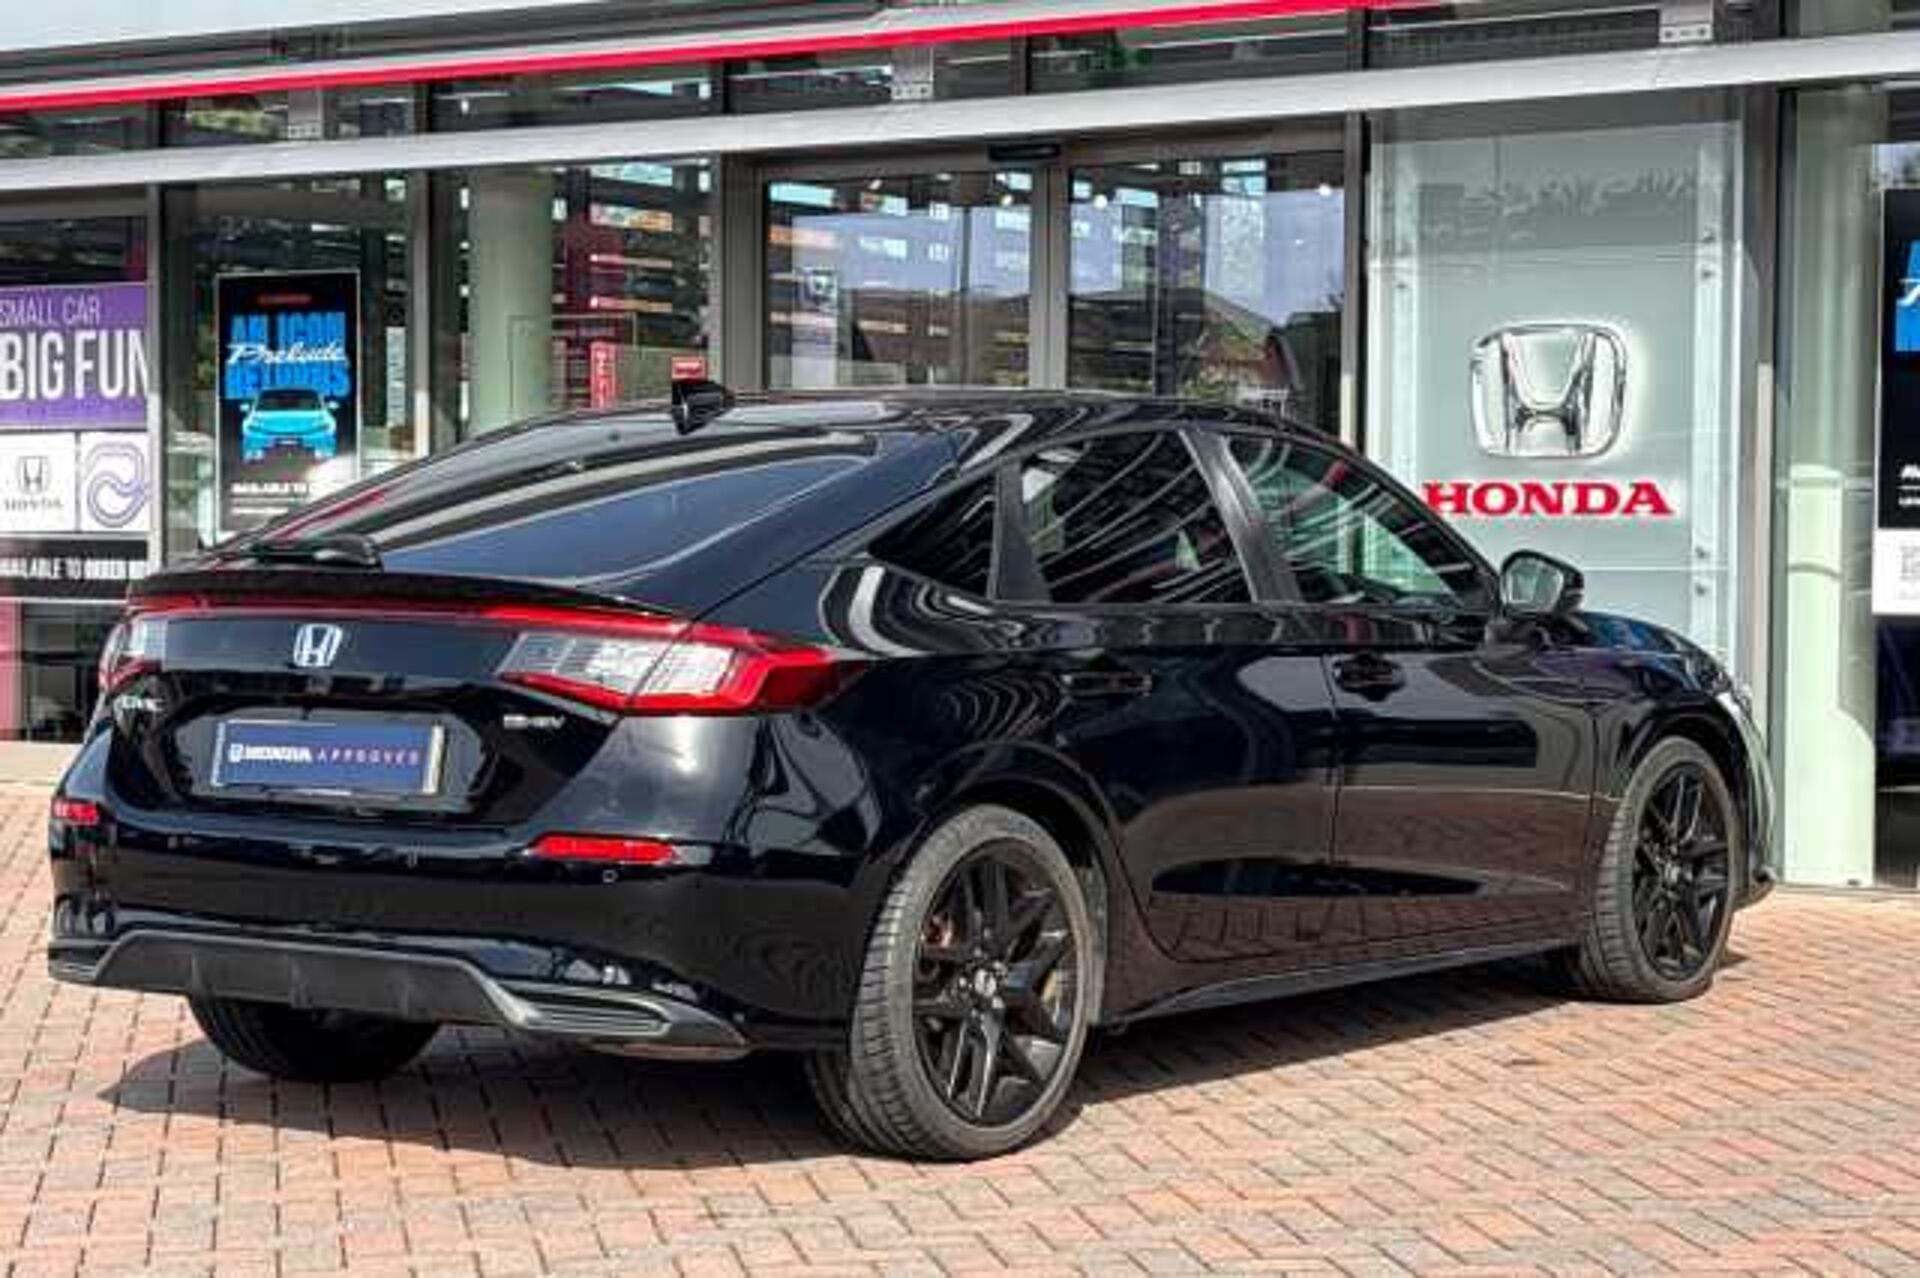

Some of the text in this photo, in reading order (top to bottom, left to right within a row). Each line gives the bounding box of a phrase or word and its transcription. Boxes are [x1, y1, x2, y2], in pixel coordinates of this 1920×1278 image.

[0, 295, 100, 327] SMALL CAR
[0, 331, 64, 400] BIG
[1423, 481, 1674, 516] HONDA
[317, 749, 419, 766] APPROVED
